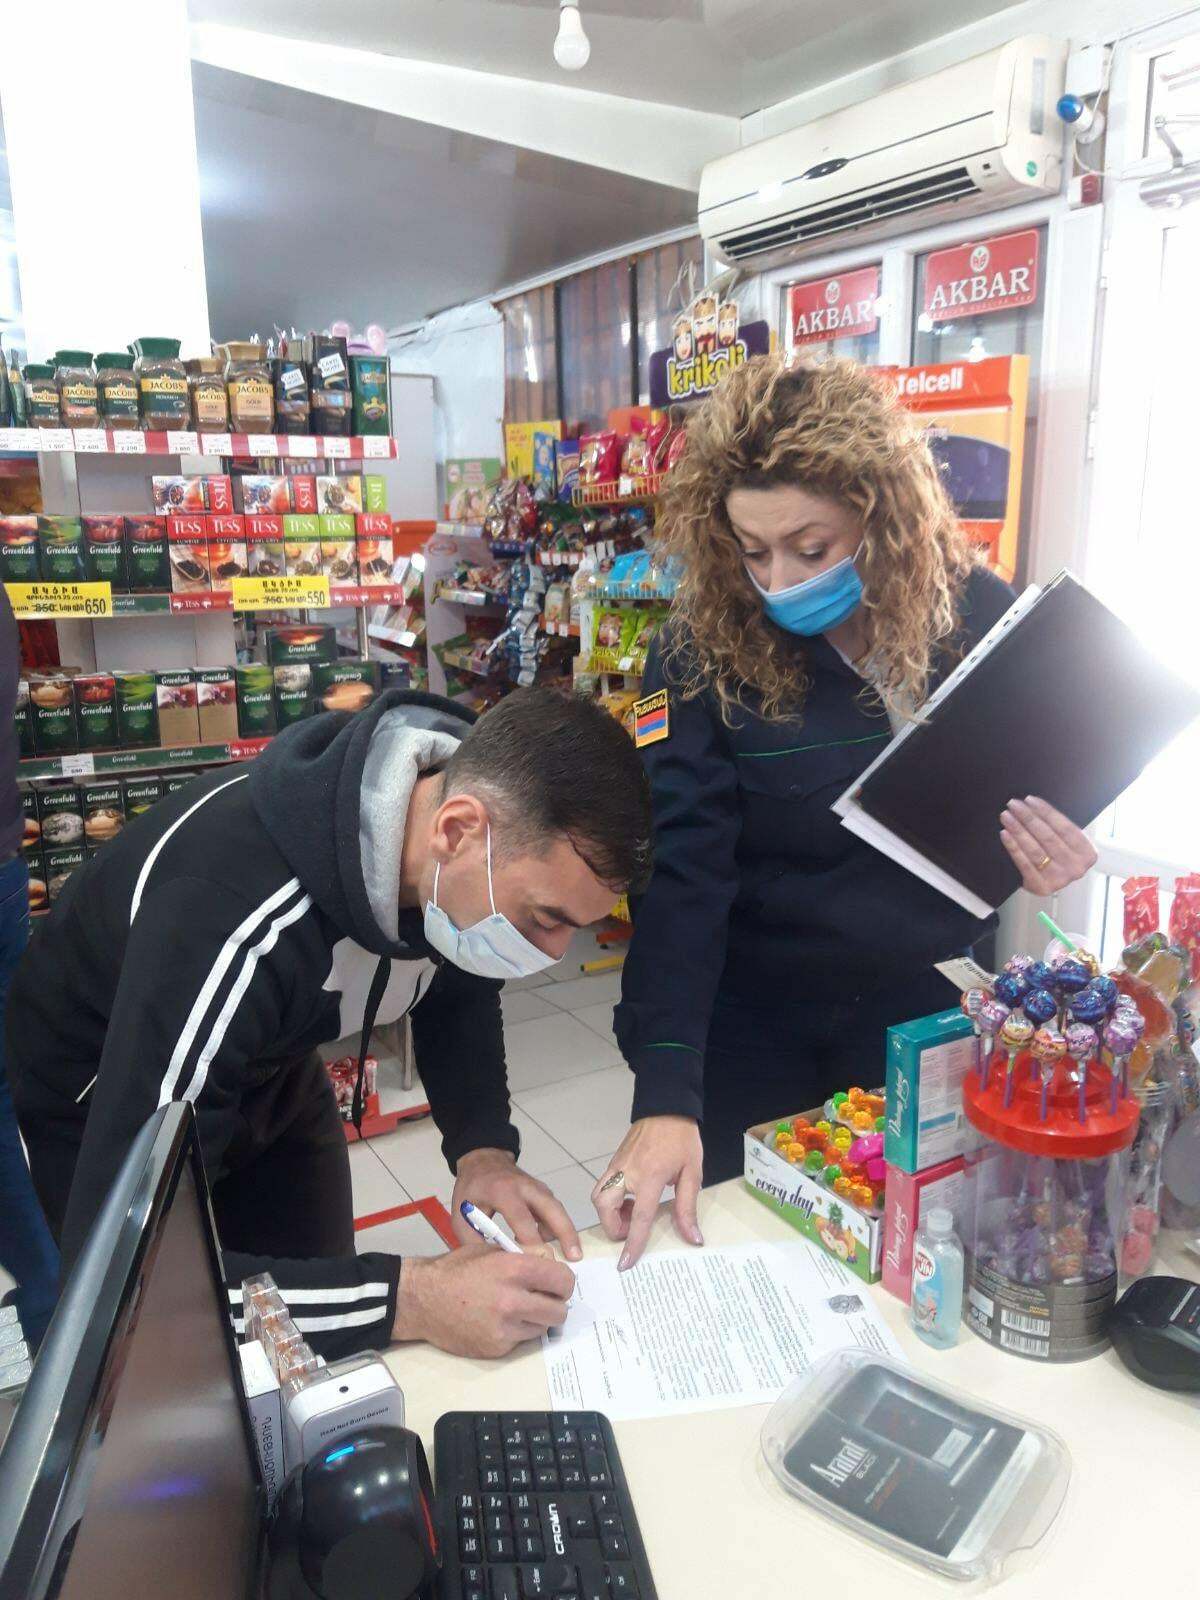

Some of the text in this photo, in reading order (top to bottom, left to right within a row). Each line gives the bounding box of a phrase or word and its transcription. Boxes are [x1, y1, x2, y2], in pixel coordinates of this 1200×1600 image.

[930, 267, 1031, 310] AKBAR
[796, 300, 873, 336] AKBAR
[150, 381, 183, 390] JACOBS
[896, 367, 964, 394] Telcell
[108, 389, 137, 397] JACOBS
[213, 480, 228, 510] TESS
[298, 482, 312, 509] TESS
[175, 519, 201, 535] TESS
[213, 519, 240, 534] TESS
[252, 521, 279, 534] TESS
[290, 519, 315, 533] TESS
[327, 519, 351, 533] TESS
[364, 516, 388, 531] TESS
[2, 546, 35, 555] Greenfield
[46, 546, 78, 555] Greenfield
[89, 545, 121, 555] Greenfield
[132, 545, 163, 554] Greenfield
[307, 590, 325, 606] 550
[85, 598, 106, 614] 650
[288, 644, 316, 653] Greenfield
[161, 675, 190, 686] Greenfield
[201, 672, 230, 682] Greenfield
[244, 692, 271, 704] Greenfield
[280, 691, 307, 701] Greenfield
[38, 707, 70, 719] Greenfield
[81, 705, 112, 716] Greenfield
[122, 702, 153, 713] Greenfield
[112, 754, 137, 764] Greenfield
[170, 749, 193, 758] Greenfield
[86, 790, 119, 801] Greenfield
[127, 786, 158, 798] Greenfield
[43, 794, 76, 805] Greenfield
[50, 853, 82, 866] Greenfield
[756, 1177, 815, 1220] every day
[809, 1436, 869, 1488] Ararat
